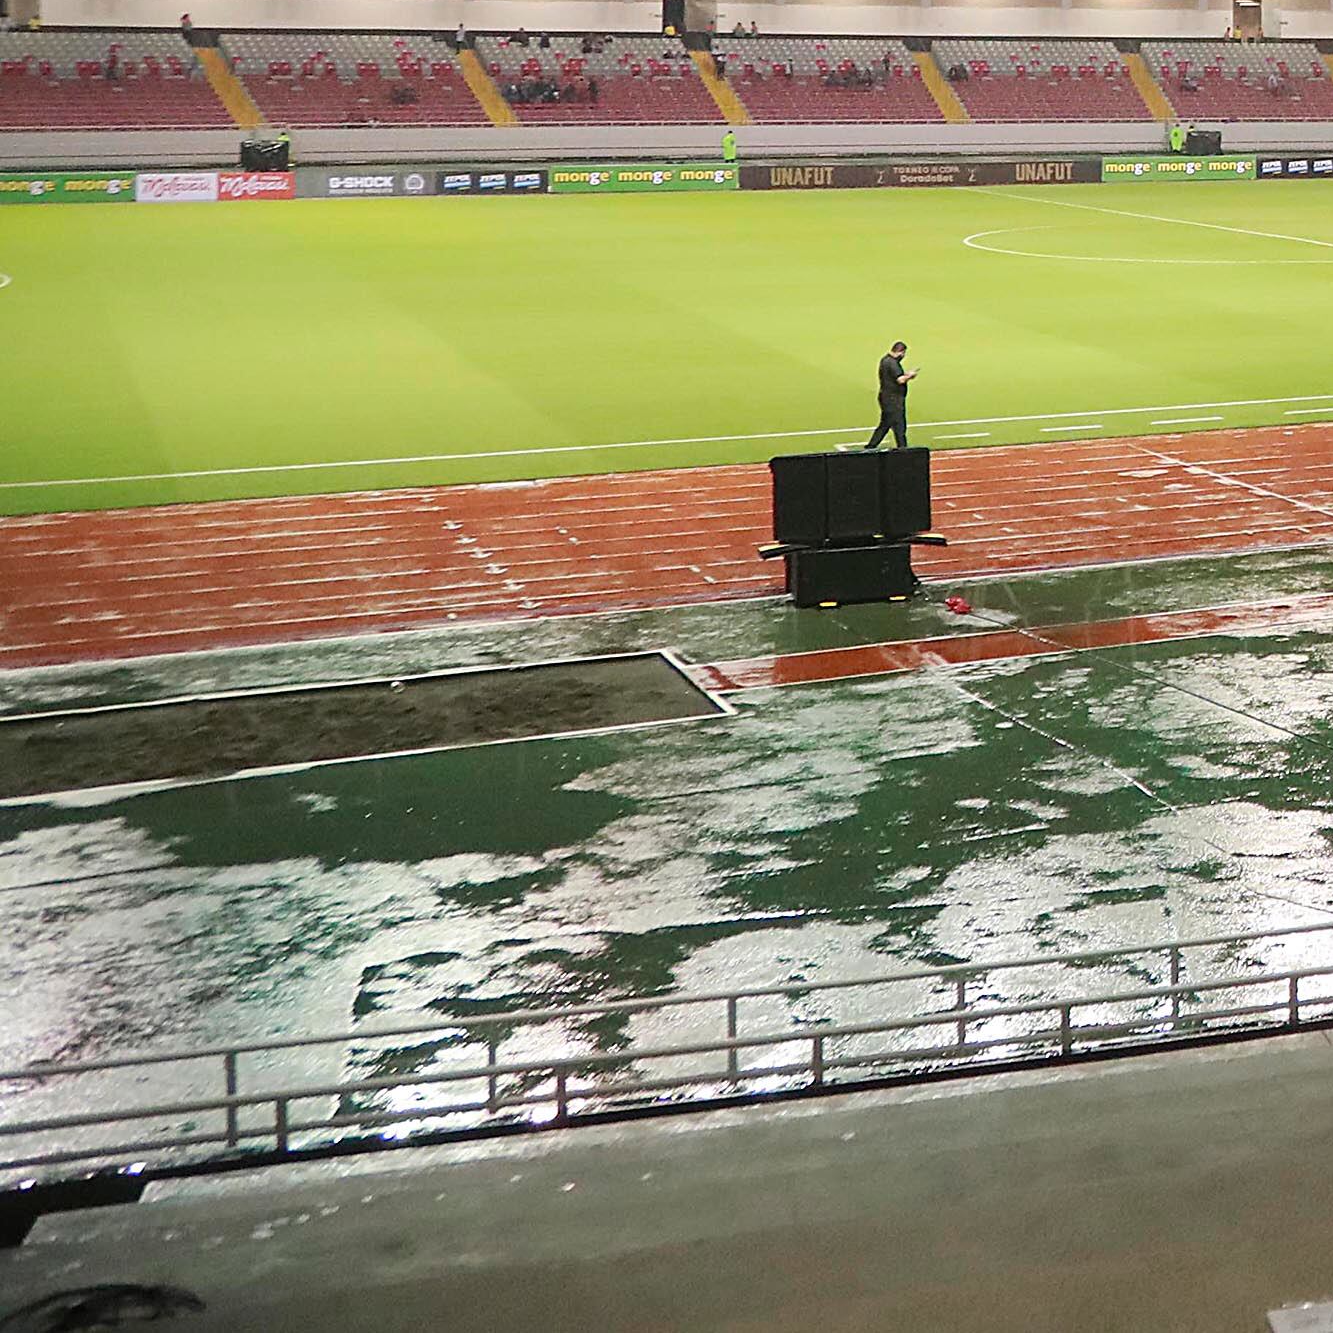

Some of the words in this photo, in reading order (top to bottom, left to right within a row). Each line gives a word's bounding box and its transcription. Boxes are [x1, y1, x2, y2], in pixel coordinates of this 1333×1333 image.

[1015, 162, 1074, 181] UNAFUT
[1105, 162, 1150, 176] monge
[1157, 161, 1202, 174] monge
[1208, 160, 1252, 173] monge
[329, 176, 394, 188] G-SHOCK
[554, 171, 610, 185] monge
[618, 170, 673, 184] monge
[680, 169, 733, 183] monge
[770, 167, 834, 186] UNAFUT
[63, 179, 133, 194] monge
